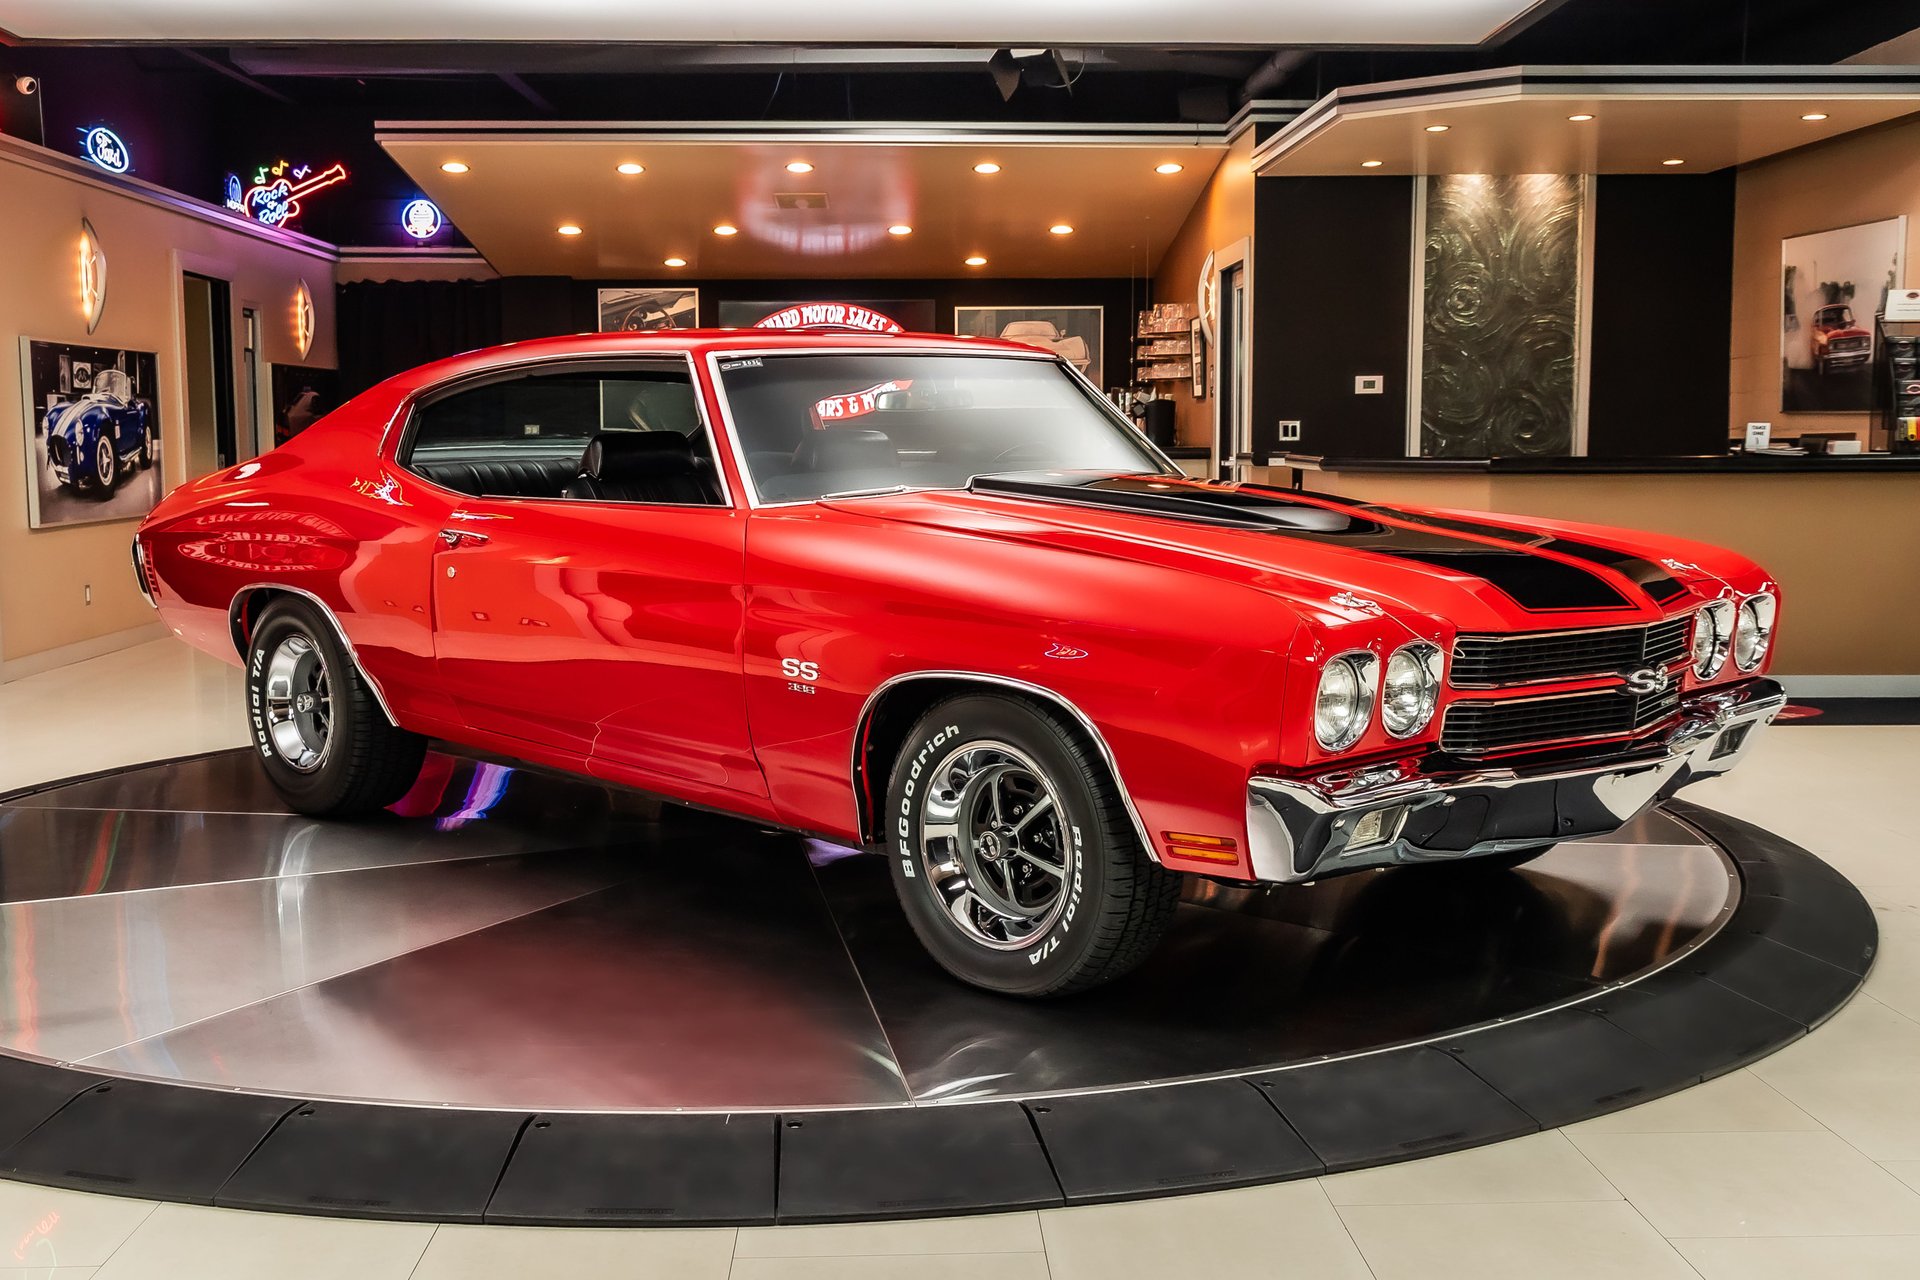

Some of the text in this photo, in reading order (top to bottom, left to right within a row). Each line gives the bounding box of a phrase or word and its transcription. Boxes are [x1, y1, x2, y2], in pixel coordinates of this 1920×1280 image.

[96, 132, 122, 167] Ford
[252, 181, 288, 206] Rock
[258, 201, 289, 224] Roll
[801, 304, 846, 325] MOTOR
[846, 306, 888, 331] SALES
[847, 396, 859, 414] &
[781, 657, 819, 681] SS
[252, 649, 273, 758] Radial T/A
[897, 723, 960, 879] BFGoodrich
[1028, 825, 1084, 967] Radial T/A
